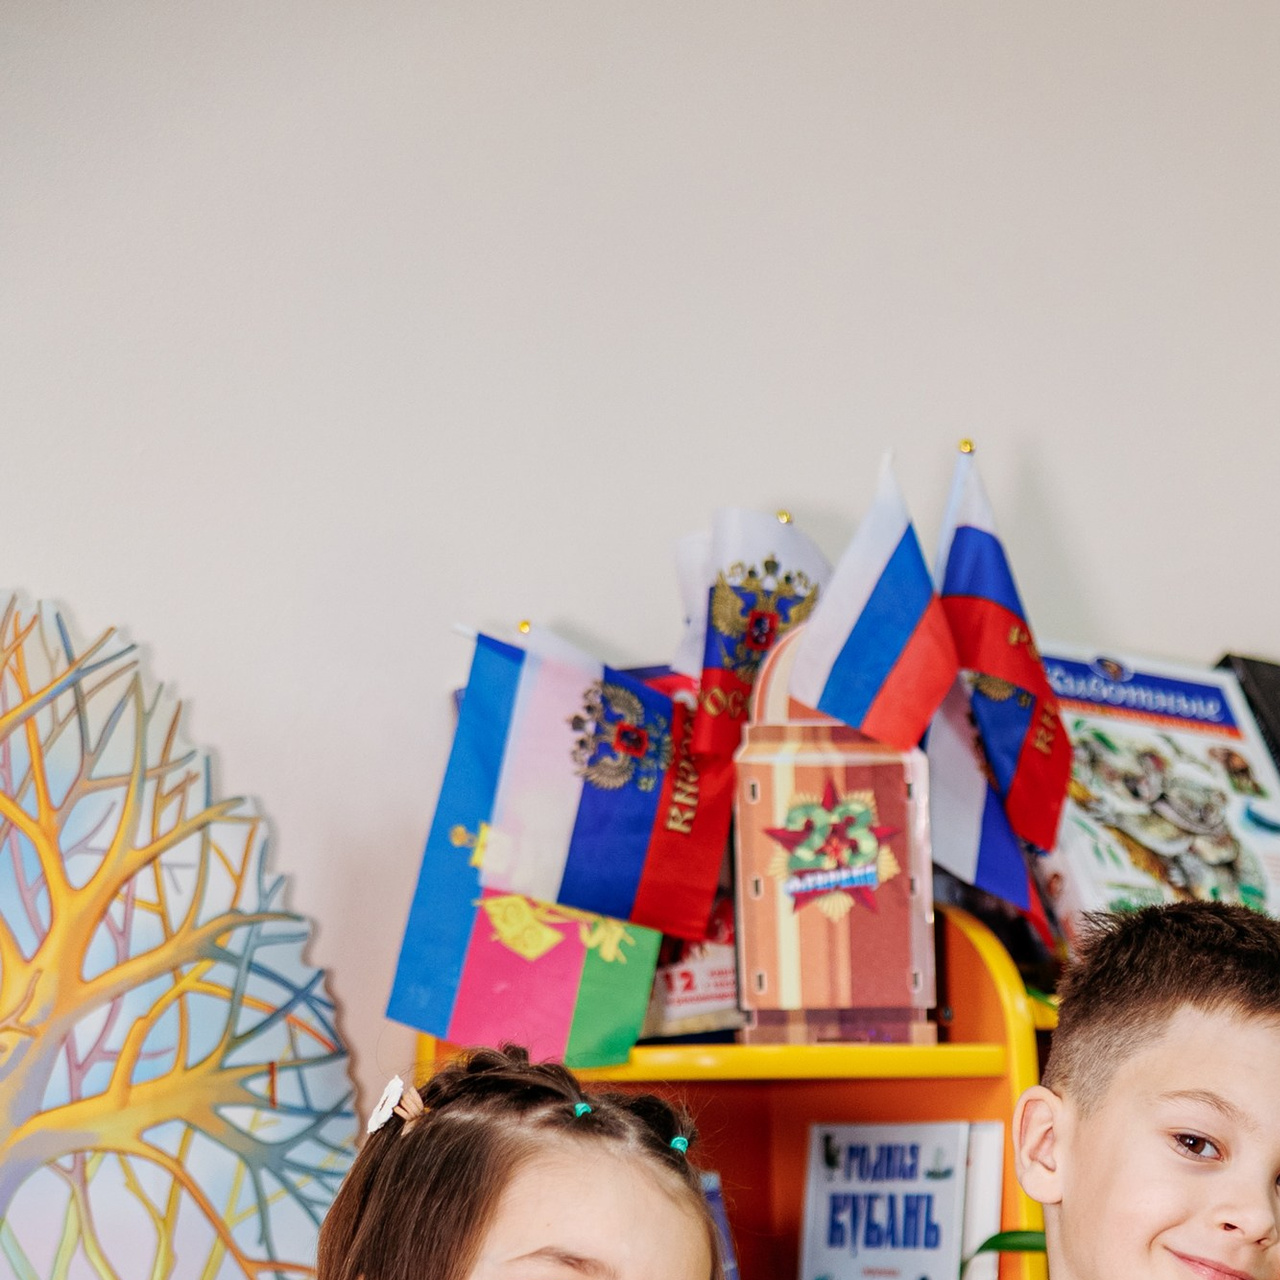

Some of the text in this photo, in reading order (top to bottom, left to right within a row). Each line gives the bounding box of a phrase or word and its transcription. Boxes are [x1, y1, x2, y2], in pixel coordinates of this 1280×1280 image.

[786, 802, 878, 869] 23
[845, 1143, 920, 1181] РОДНАЯ
[829, 1193, 940, 1257] КУБАНЬ
